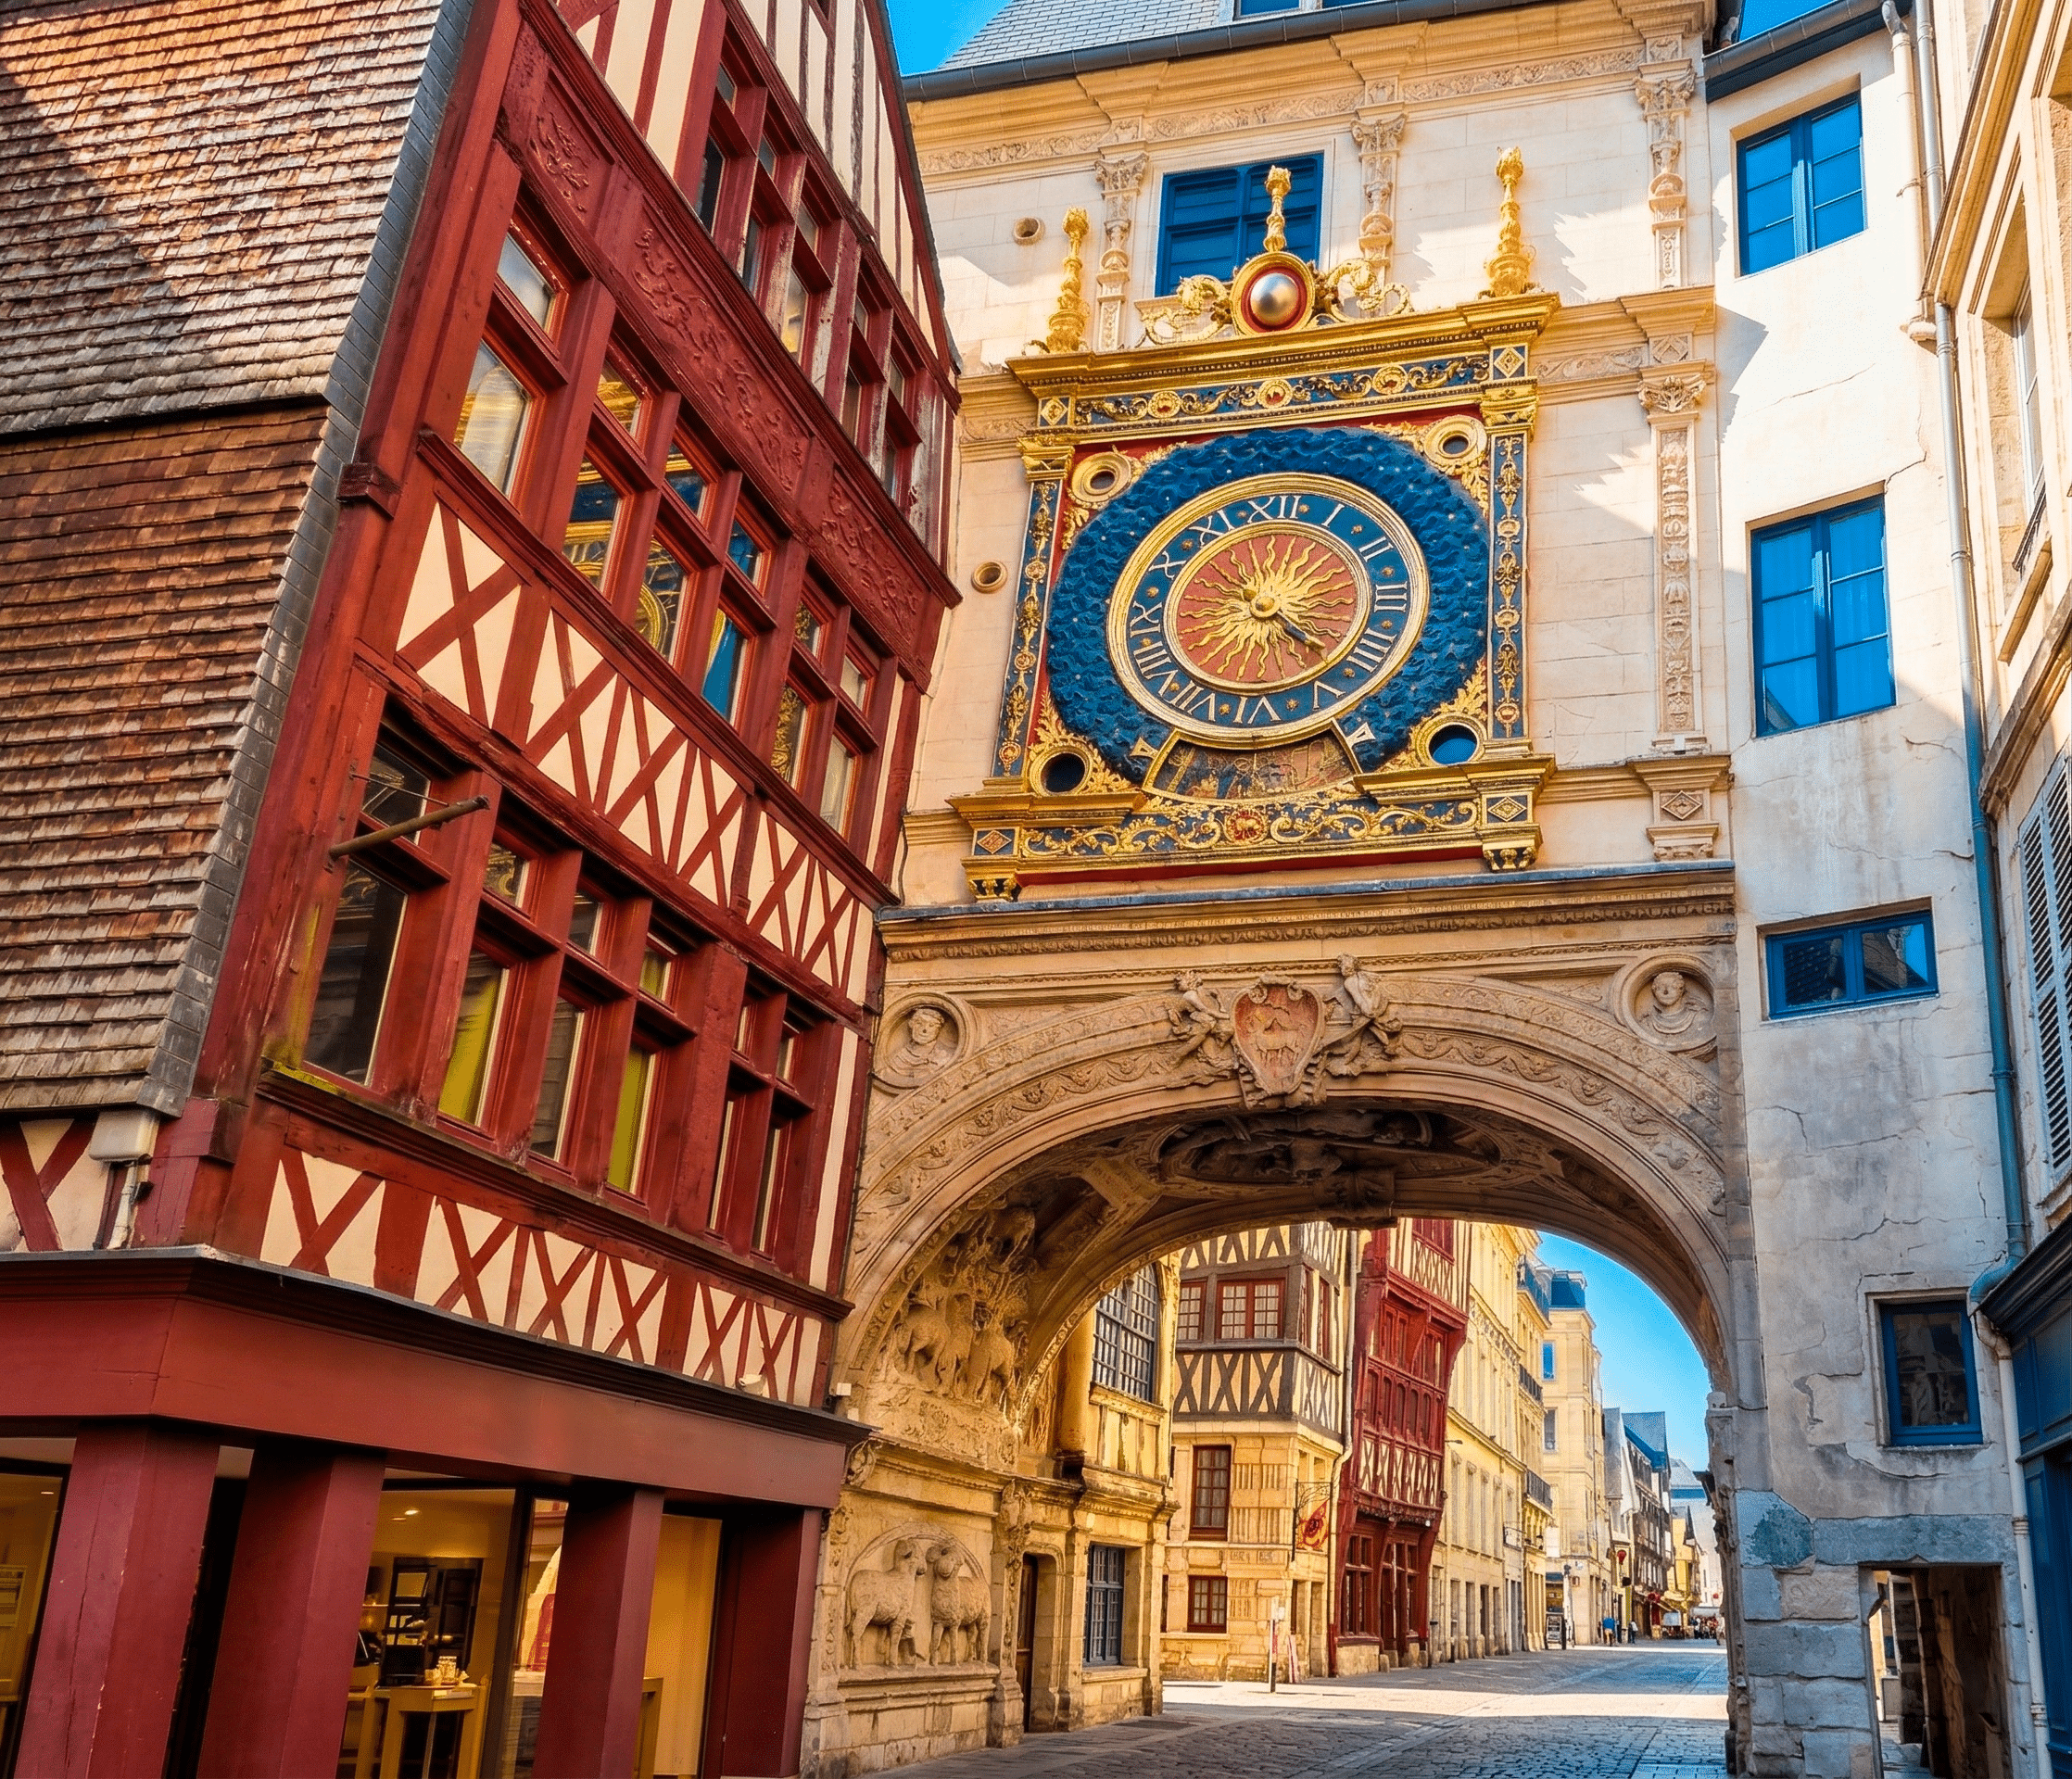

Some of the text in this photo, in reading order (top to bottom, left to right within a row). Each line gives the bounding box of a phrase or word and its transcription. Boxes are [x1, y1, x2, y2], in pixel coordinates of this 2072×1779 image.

[1247, 495, 1302, 524] XII
[1321, 503, 1346, 528] I
[1188, 510, 1235, 549] XI
[1358, 536, 1394, 562] II
[1148, 550, 1187, 580] X
[1373, 581, 1408, 612] III
[1130, 600, 1163, 638] IX
[1346, 627, 1397, 674] IIII
[1133, 640, 1179, 697] VIII
[1166, 679, 1217, 722] VII
[1232, 696, 1282, 725] VI
[1312, 680, 1346, 711] V
